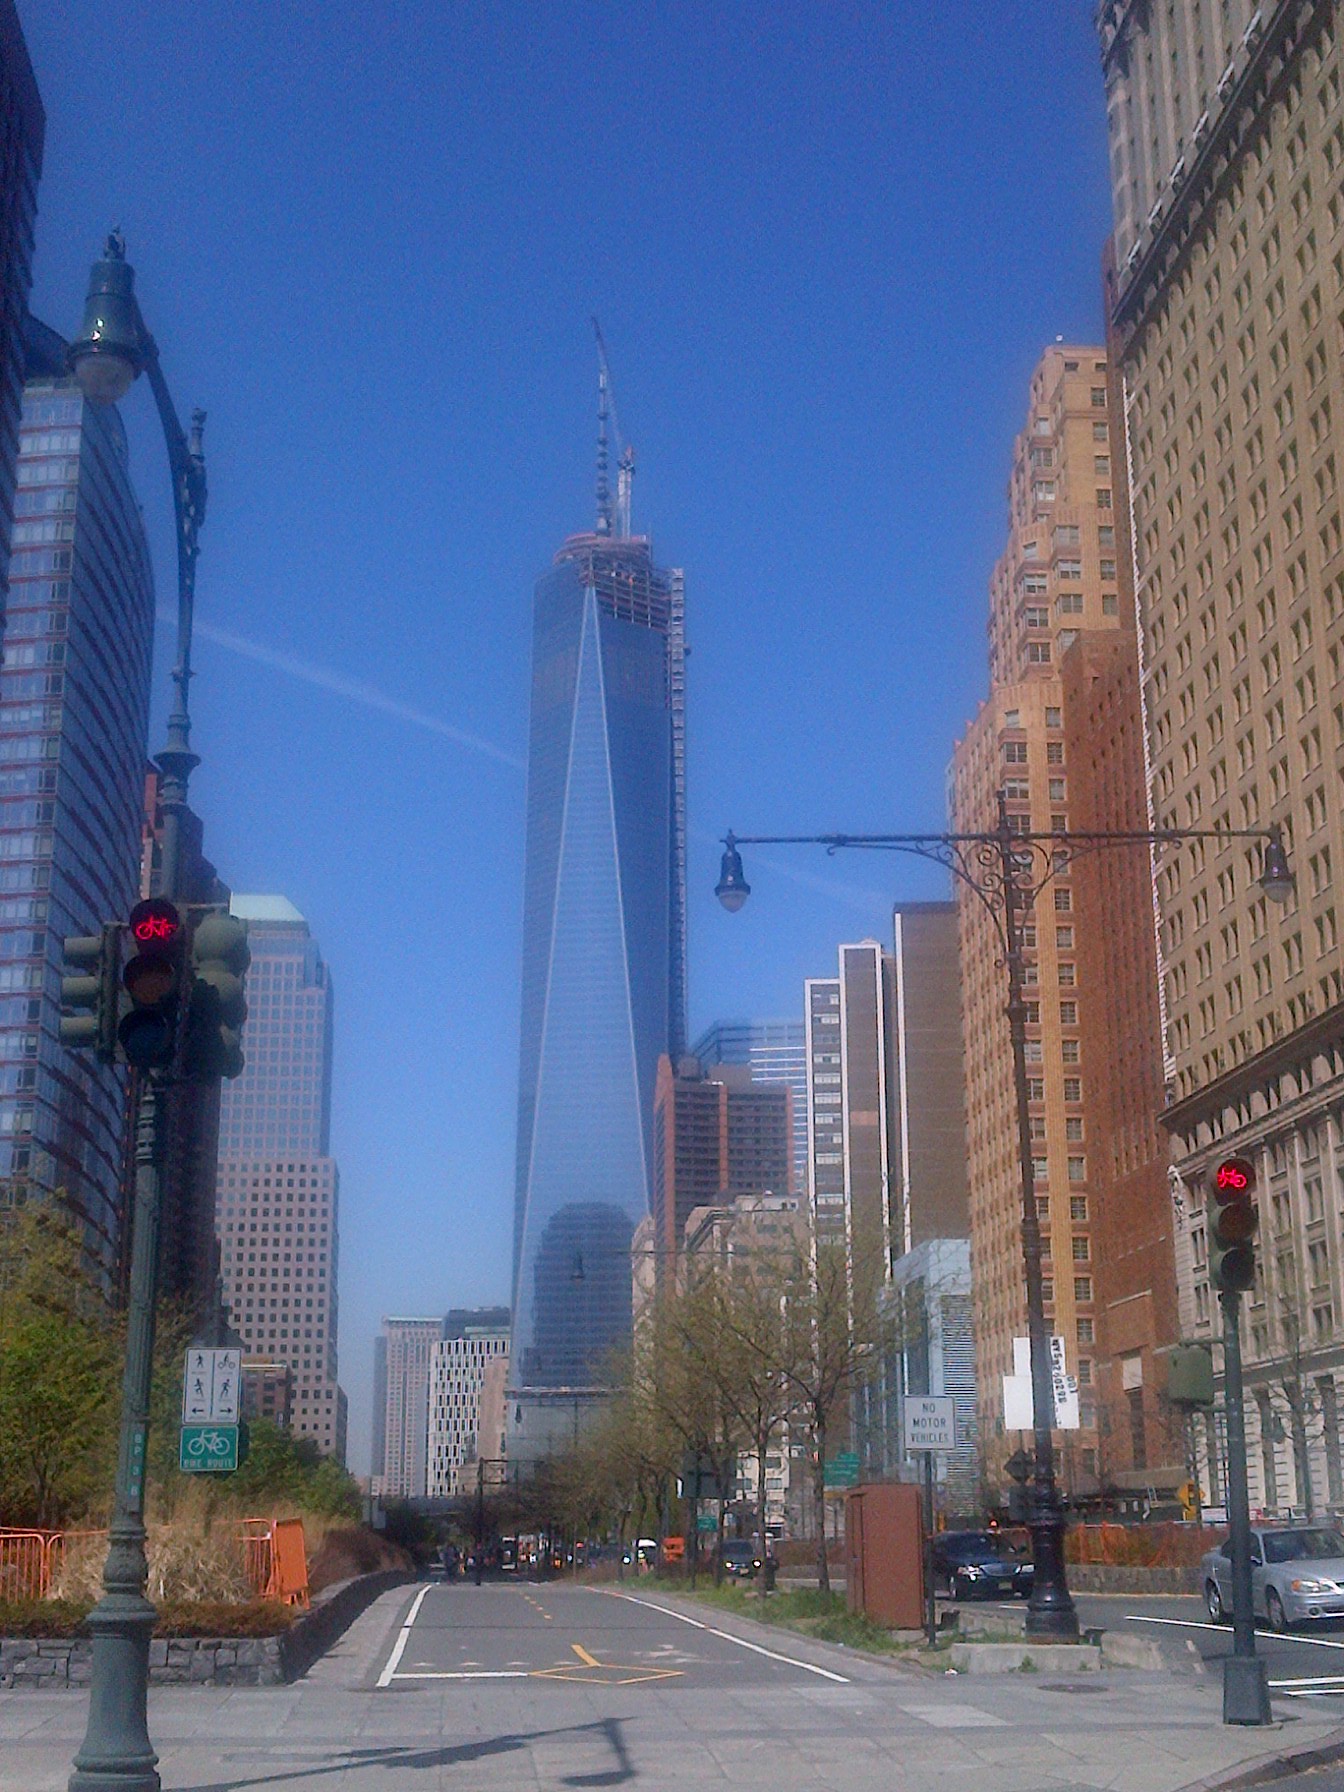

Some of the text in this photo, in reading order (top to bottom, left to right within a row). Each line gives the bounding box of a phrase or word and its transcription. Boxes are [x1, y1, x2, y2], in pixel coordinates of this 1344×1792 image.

[922, 1402, 936, 1413] NO
[912, 1417, 947, 1428] MOTOR
[911, 1431, 949, 1443] VEHICLES
[183, 1458, 234, 1468] BIKE ROUTE
